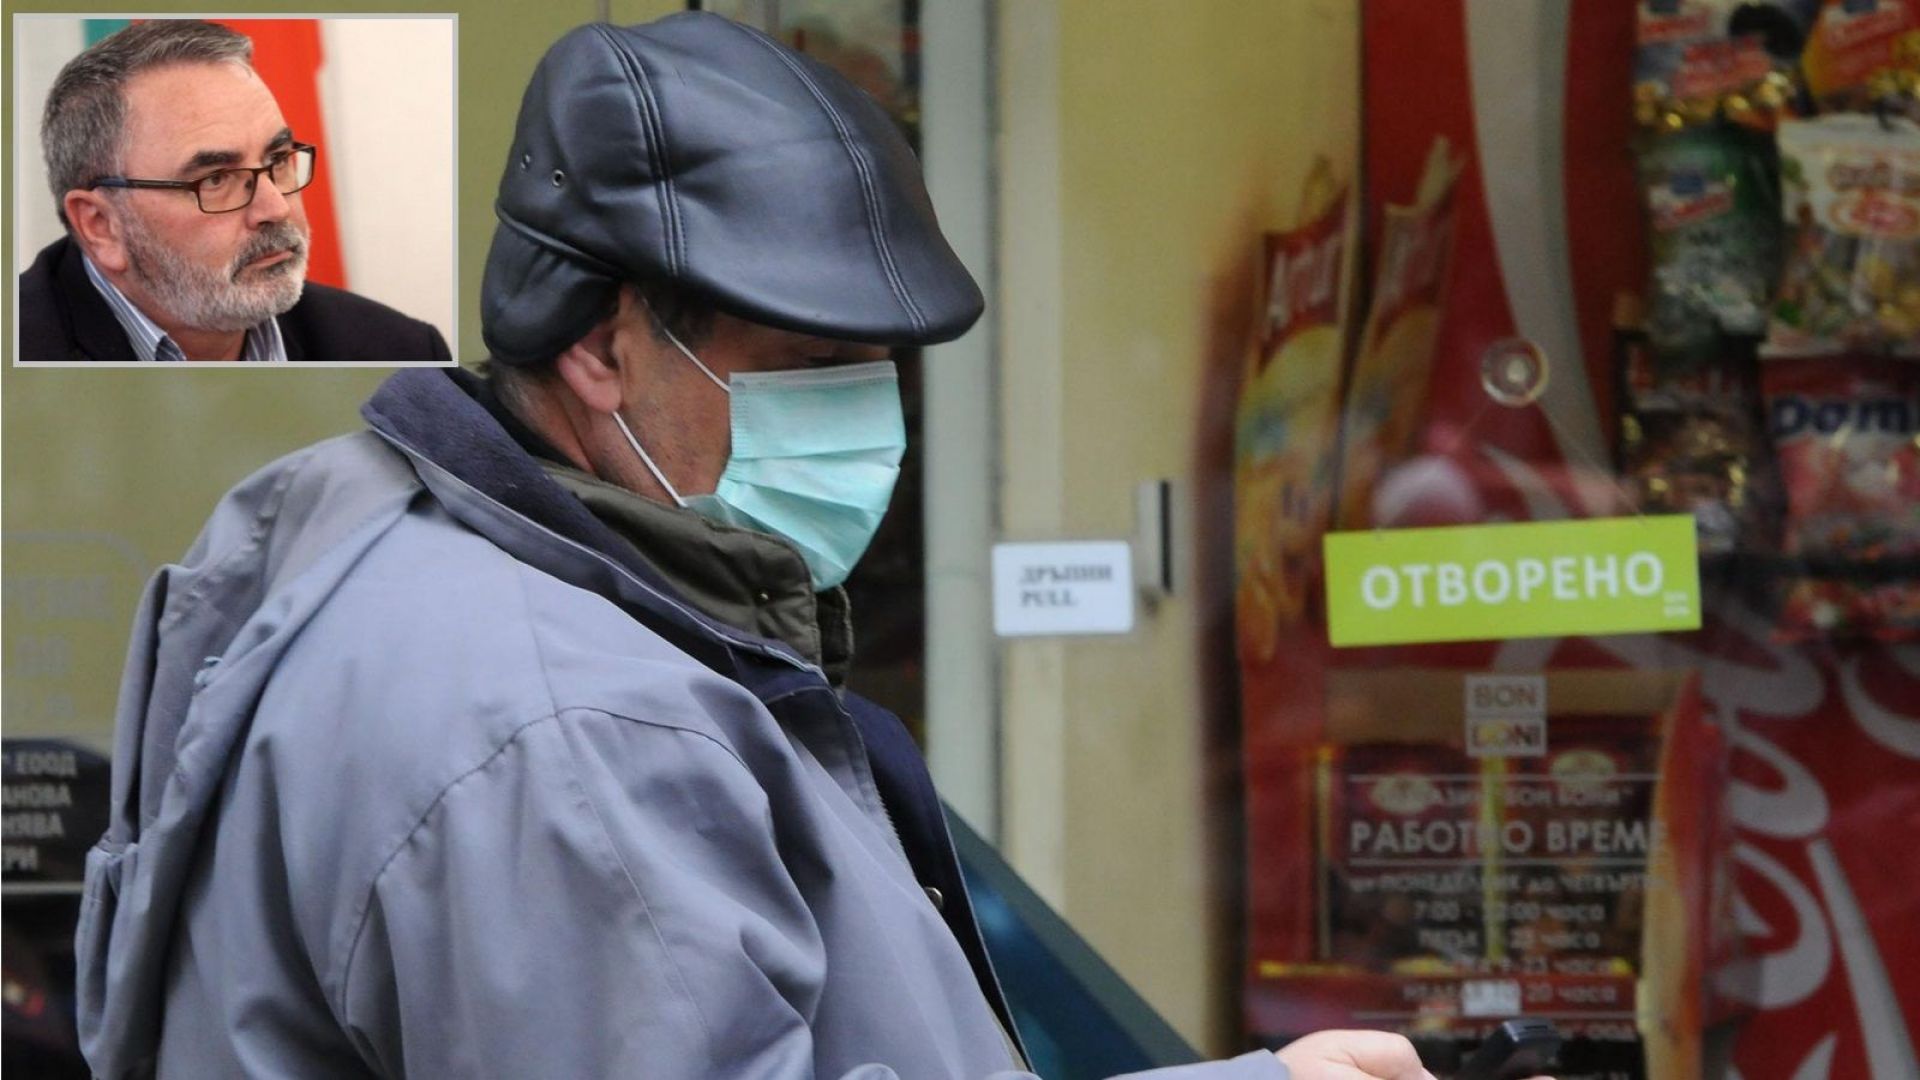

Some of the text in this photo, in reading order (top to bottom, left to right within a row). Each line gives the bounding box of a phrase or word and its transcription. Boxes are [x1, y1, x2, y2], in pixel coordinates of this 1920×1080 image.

[1361, 551, 1664, 610] ОТВОРЕНО
[1020, 589, 1079, 607] PULL
[1474, 685, 1537, 708] BON
[16, 752, 77, 776] ЕООД
